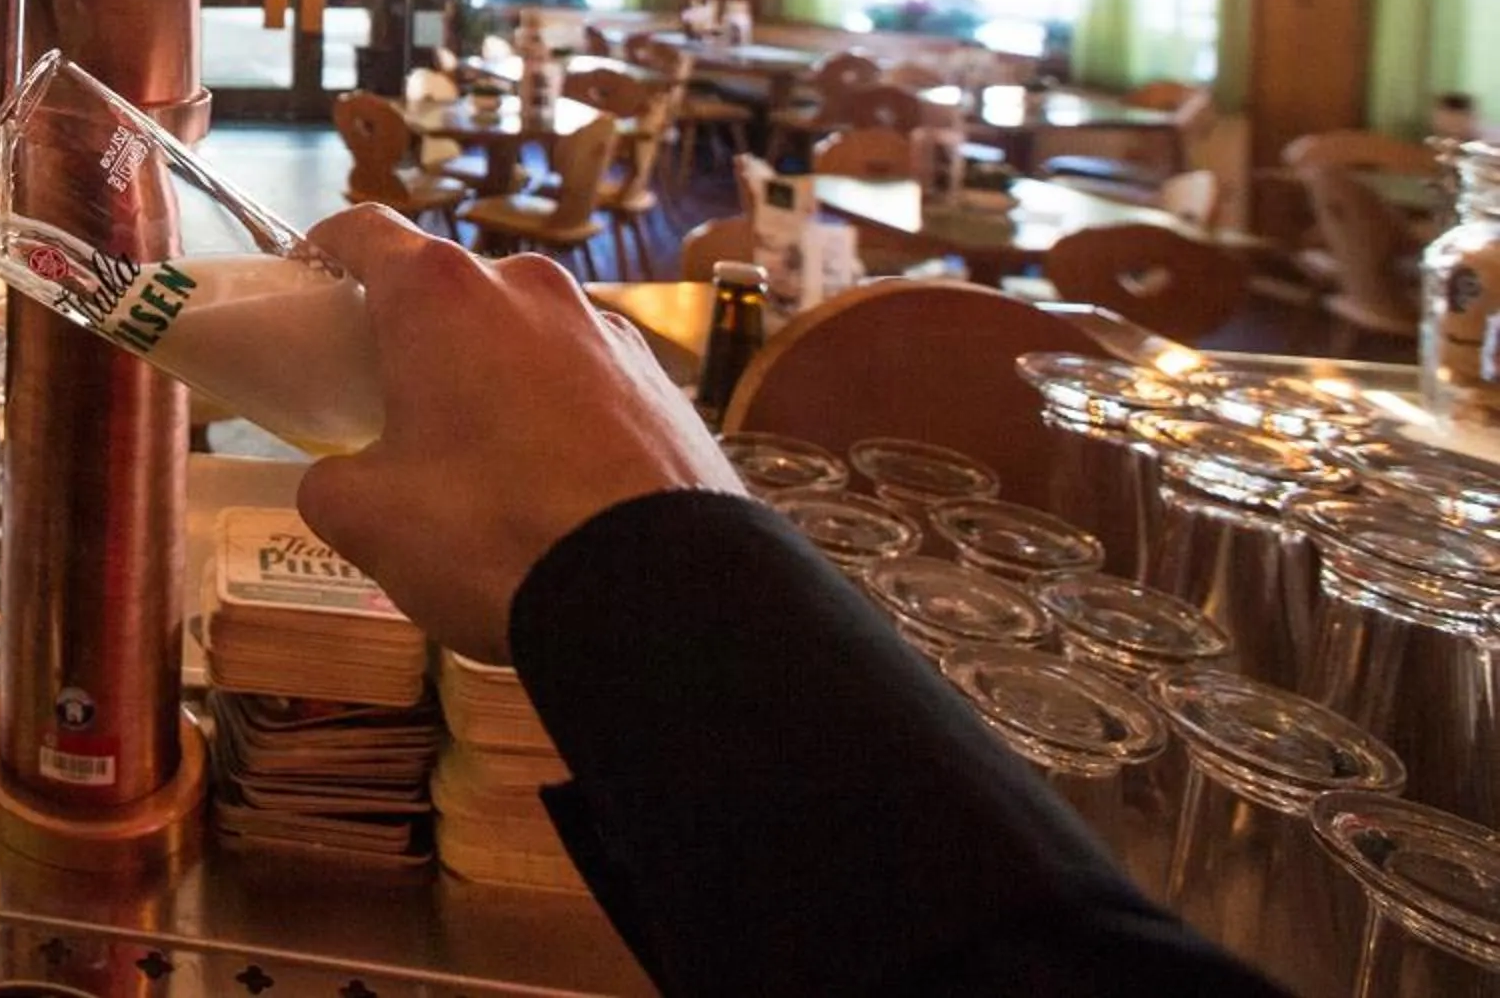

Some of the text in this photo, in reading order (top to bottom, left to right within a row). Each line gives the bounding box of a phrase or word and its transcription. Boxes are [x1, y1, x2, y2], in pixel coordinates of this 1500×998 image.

[114, 262, 197, 352] ILSEN
[259, 546, 358, 580] PILSE
[269, 533, 334, 559] Ita
